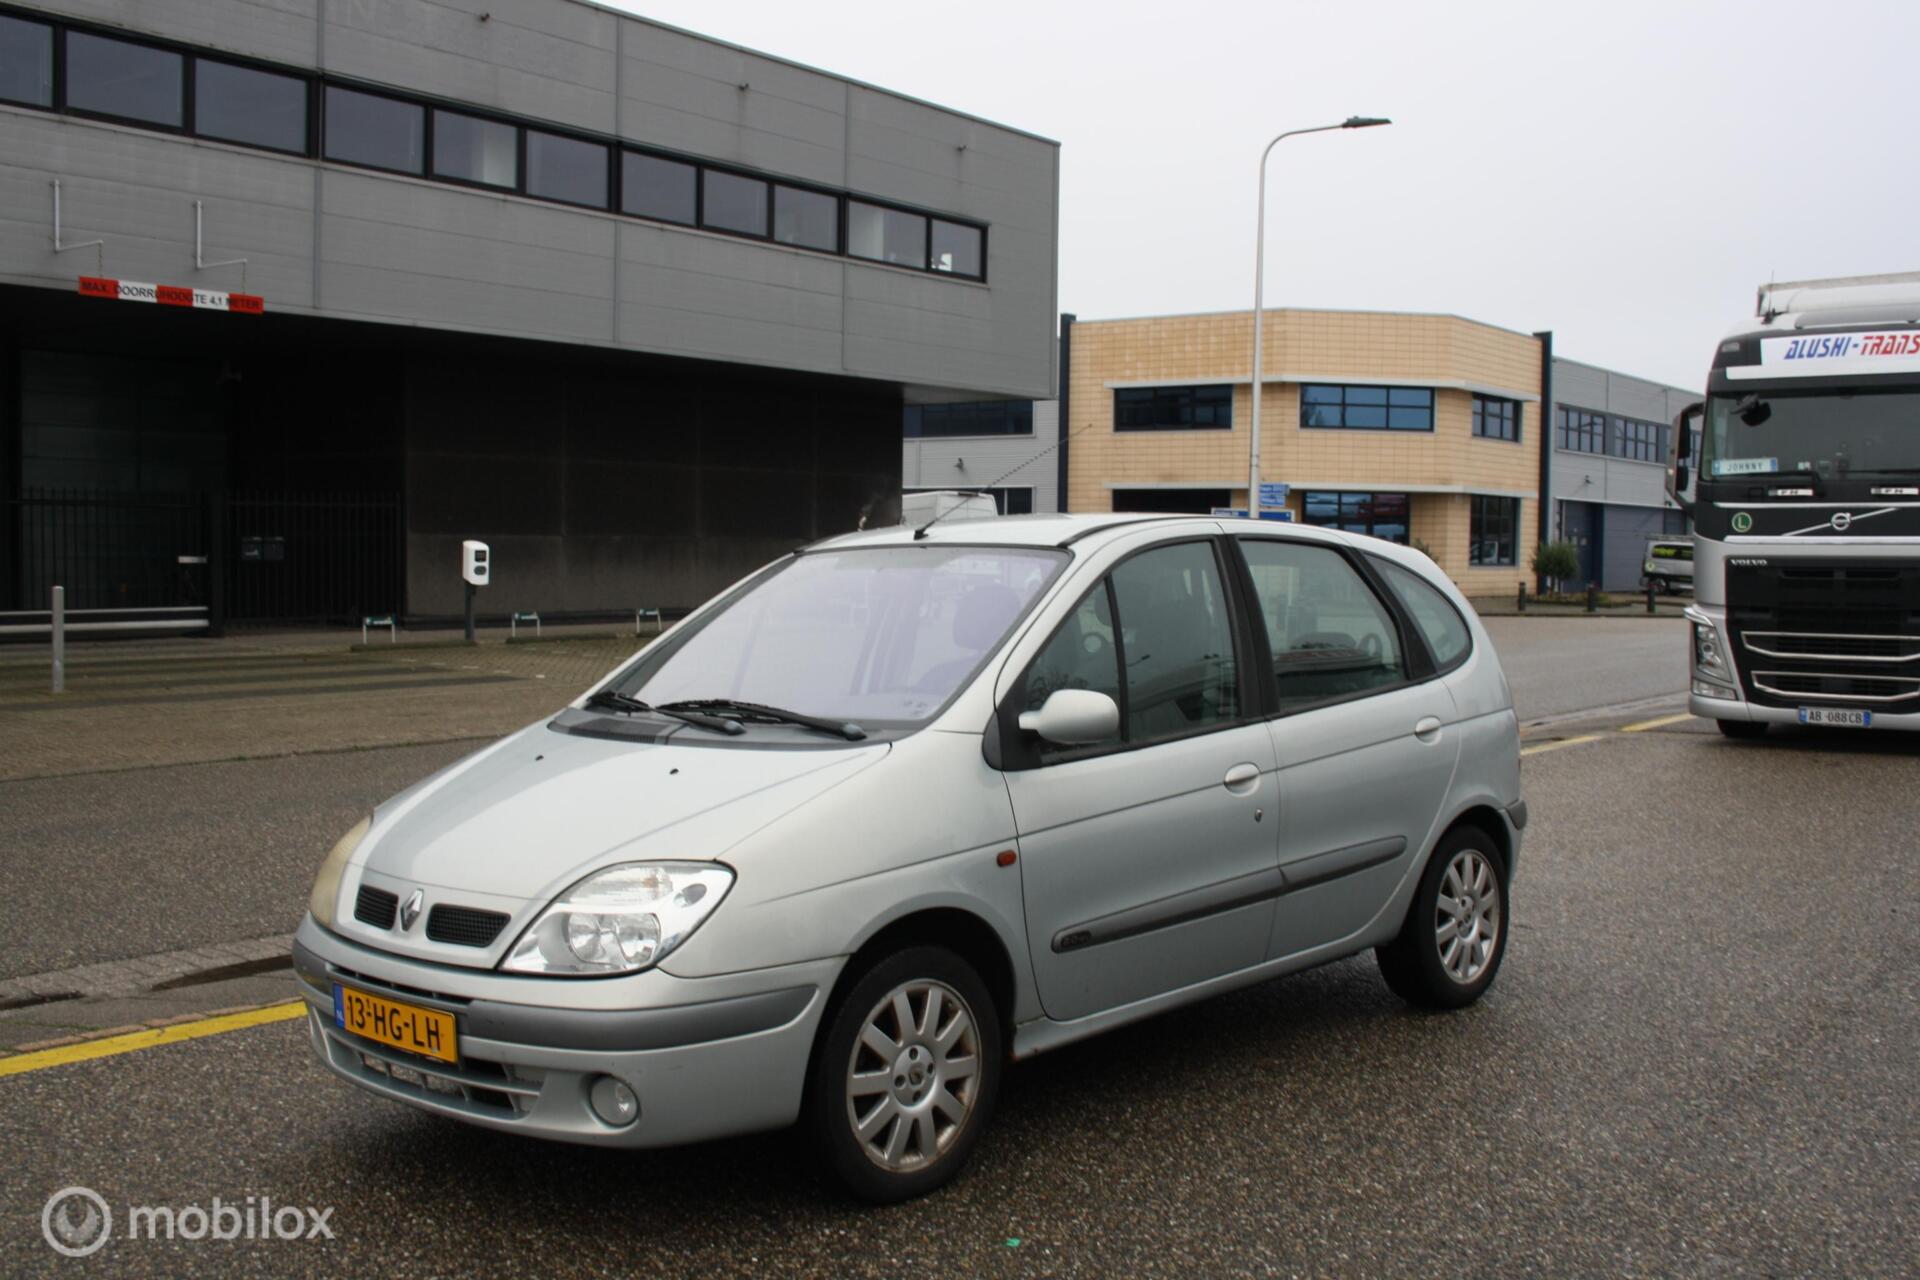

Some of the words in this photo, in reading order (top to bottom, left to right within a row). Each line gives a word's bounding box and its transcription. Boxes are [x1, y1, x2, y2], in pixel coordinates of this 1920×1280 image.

[1727, 462, 1763, 471] JOHNNY
[1738, 516, 1747, 528] L
[1809, 711, 1822, 720] AB
[347, 995, 441, 1051] 13-HG-LH
